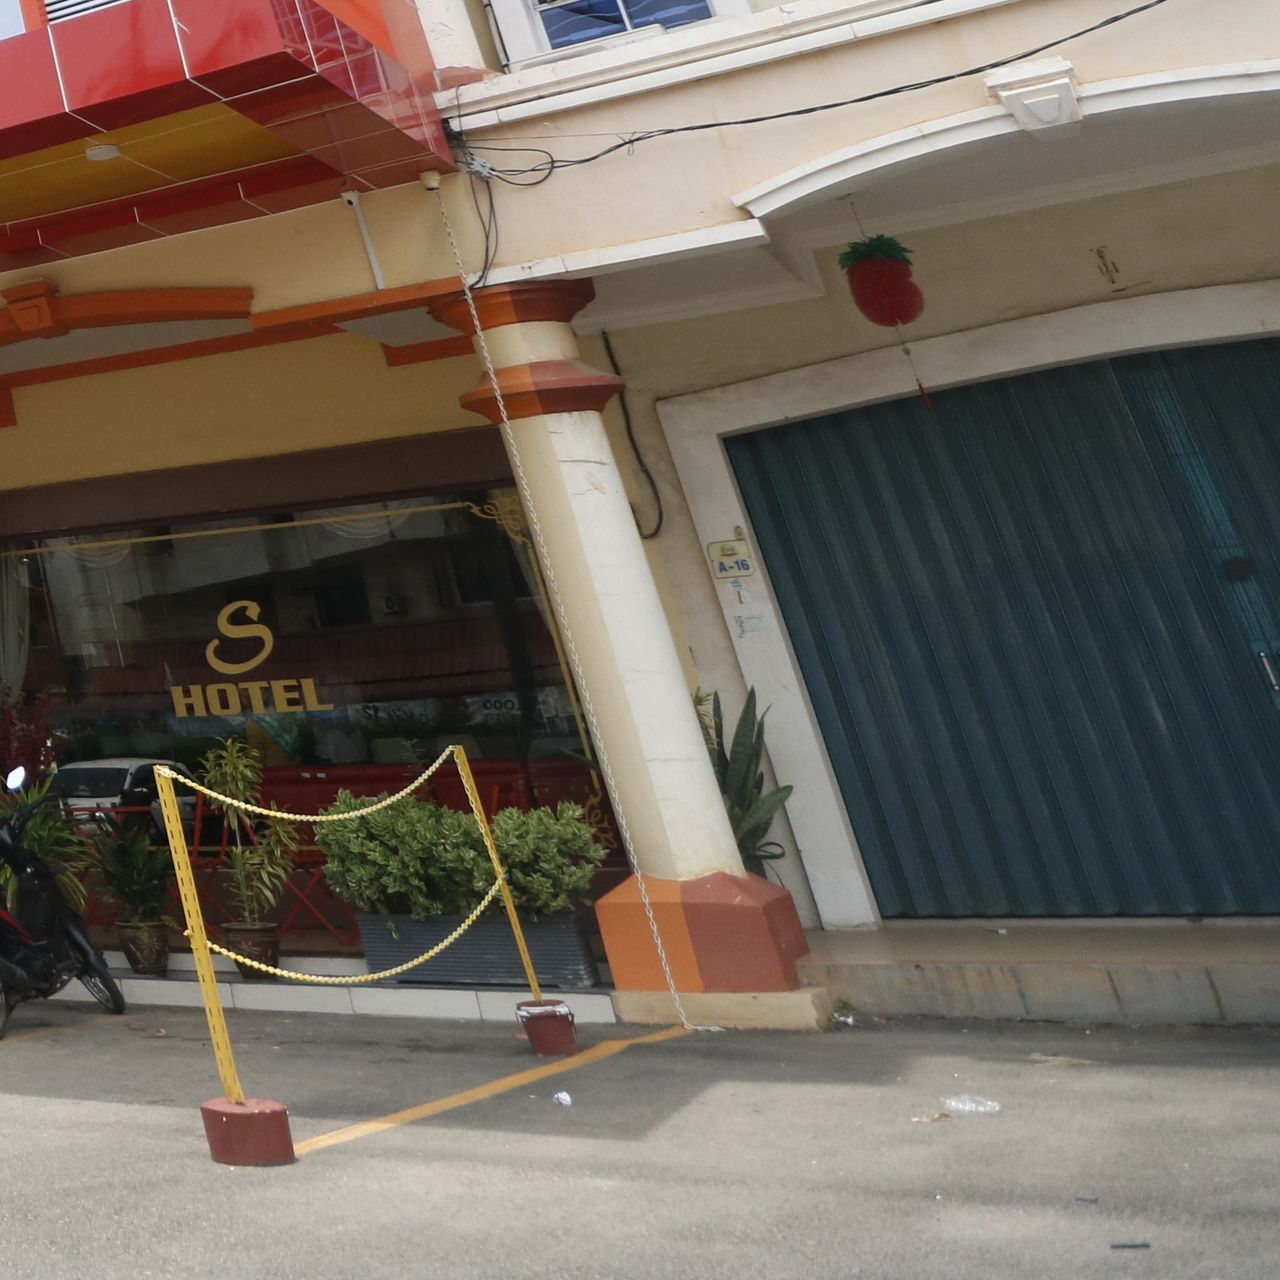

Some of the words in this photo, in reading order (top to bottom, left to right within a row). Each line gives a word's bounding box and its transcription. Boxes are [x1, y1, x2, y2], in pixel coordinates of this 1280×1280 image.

[719, 559, 750, 573] A-16
[205, 600, 274, 675] S
[170, 678, 334, 718] HOTEL
